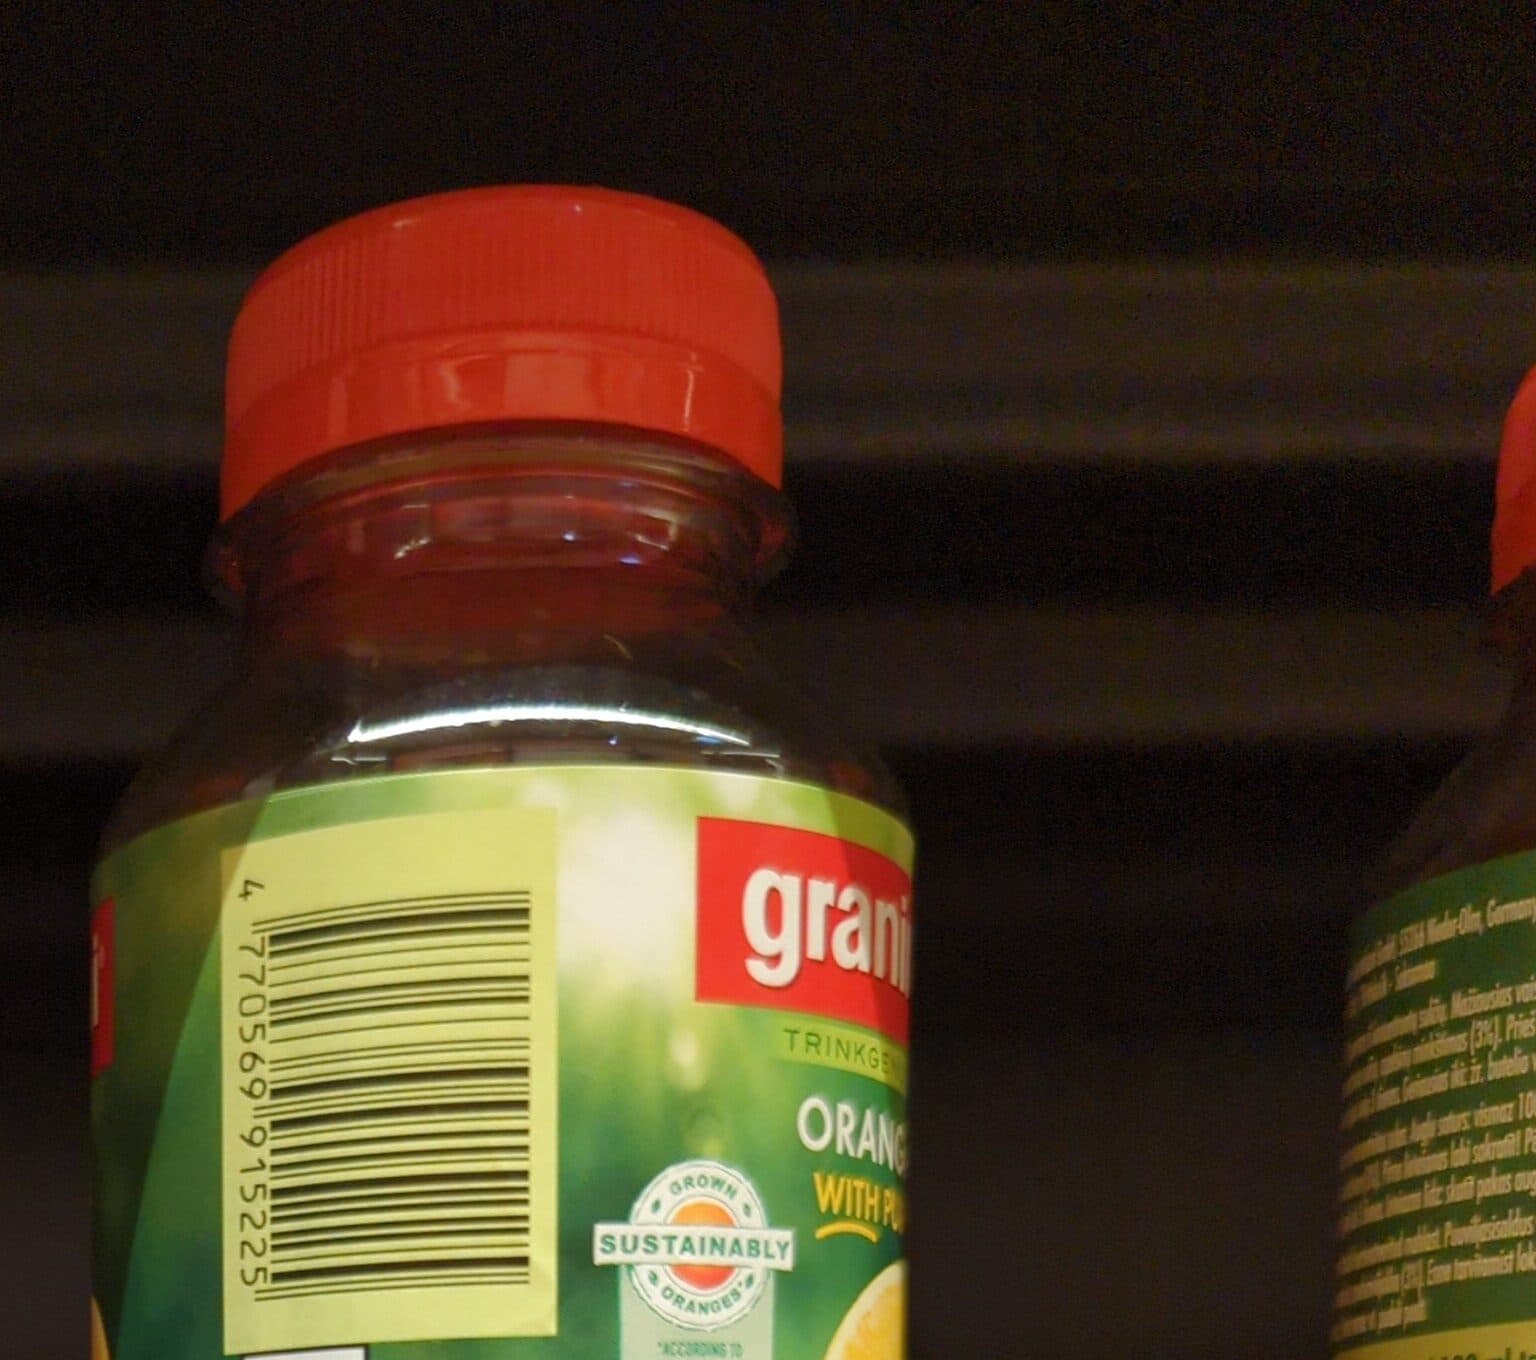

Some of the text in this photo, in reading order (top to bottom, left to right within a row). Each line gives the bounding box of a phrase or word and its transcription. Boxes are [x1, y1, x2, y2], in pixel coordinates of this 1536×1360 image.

[237, 933, 267, 1100] 770569
[239, 1124, 268, 1287] 915225
[668, 1174, 737, 1199] GROWN
[813, 1171, 880, 1224] WITH
[599, 1234, 792, 1263] SUSTAINABLY
